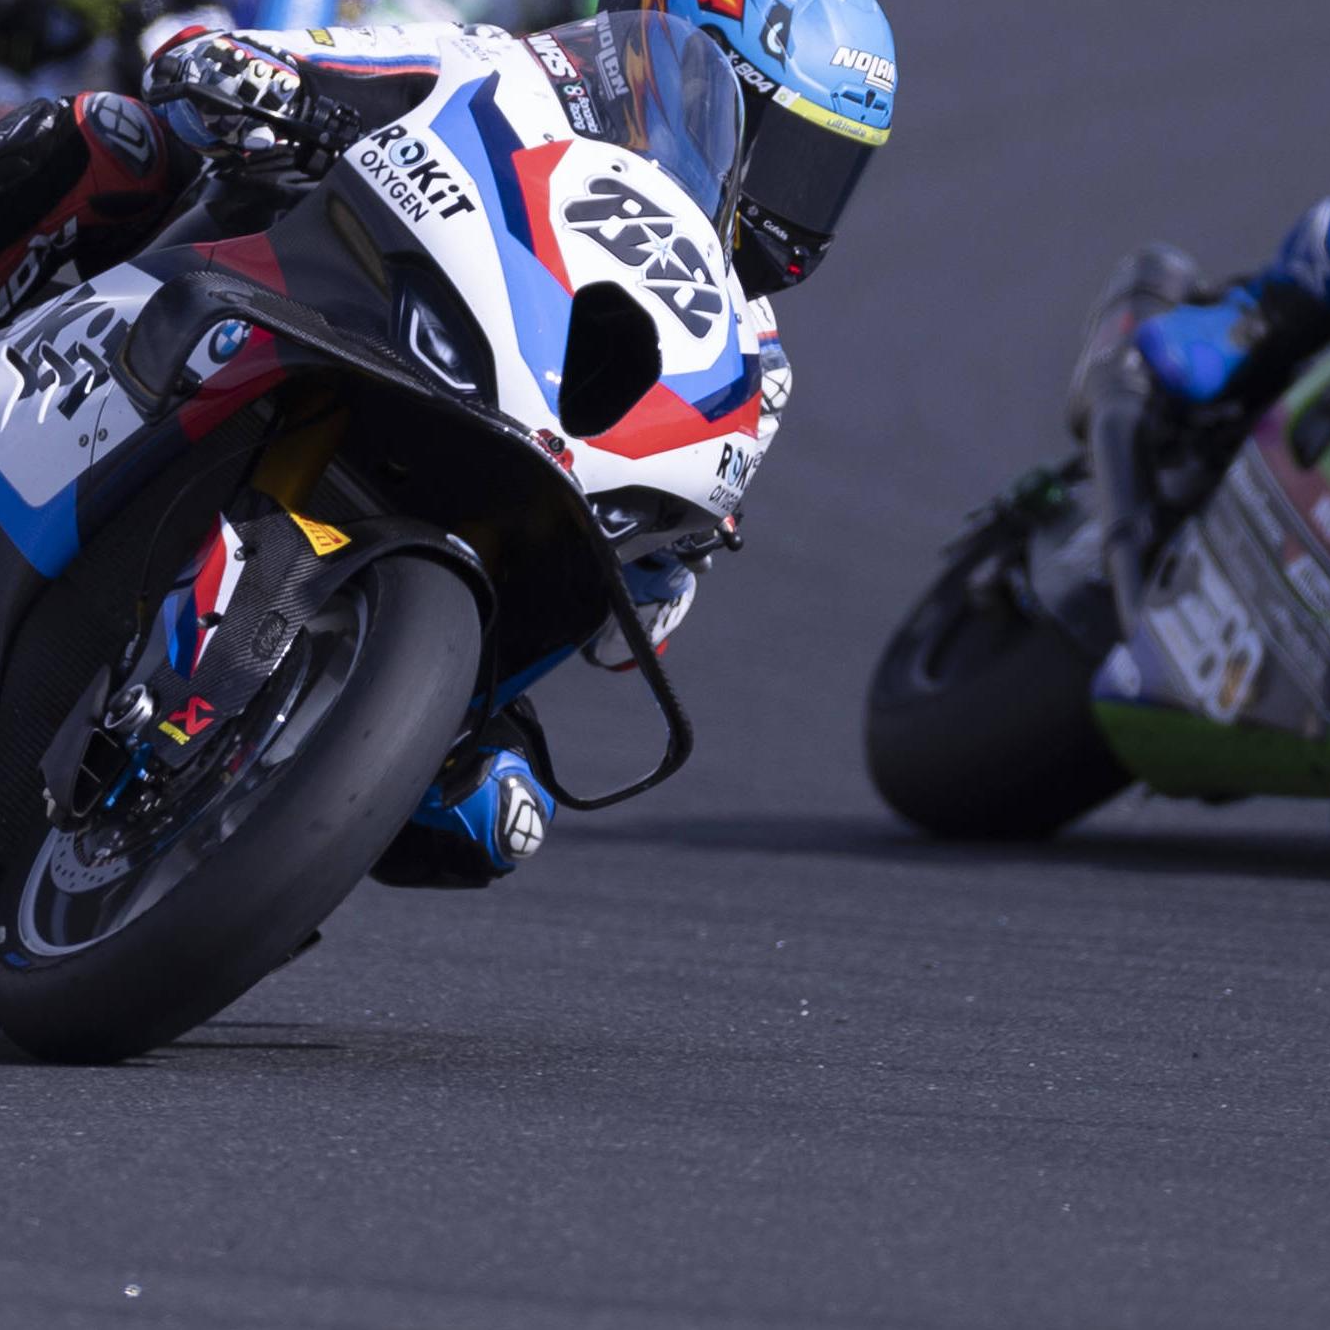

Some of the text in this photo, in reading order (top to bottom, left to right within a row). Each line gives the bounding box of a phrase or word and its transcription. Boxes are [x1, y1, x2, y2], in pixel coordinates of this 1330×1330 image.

[527, 33, 578, 78] WRS
[726, 50, 775, 93] X-804
[360, 150, 429, 222] OXYGEN
